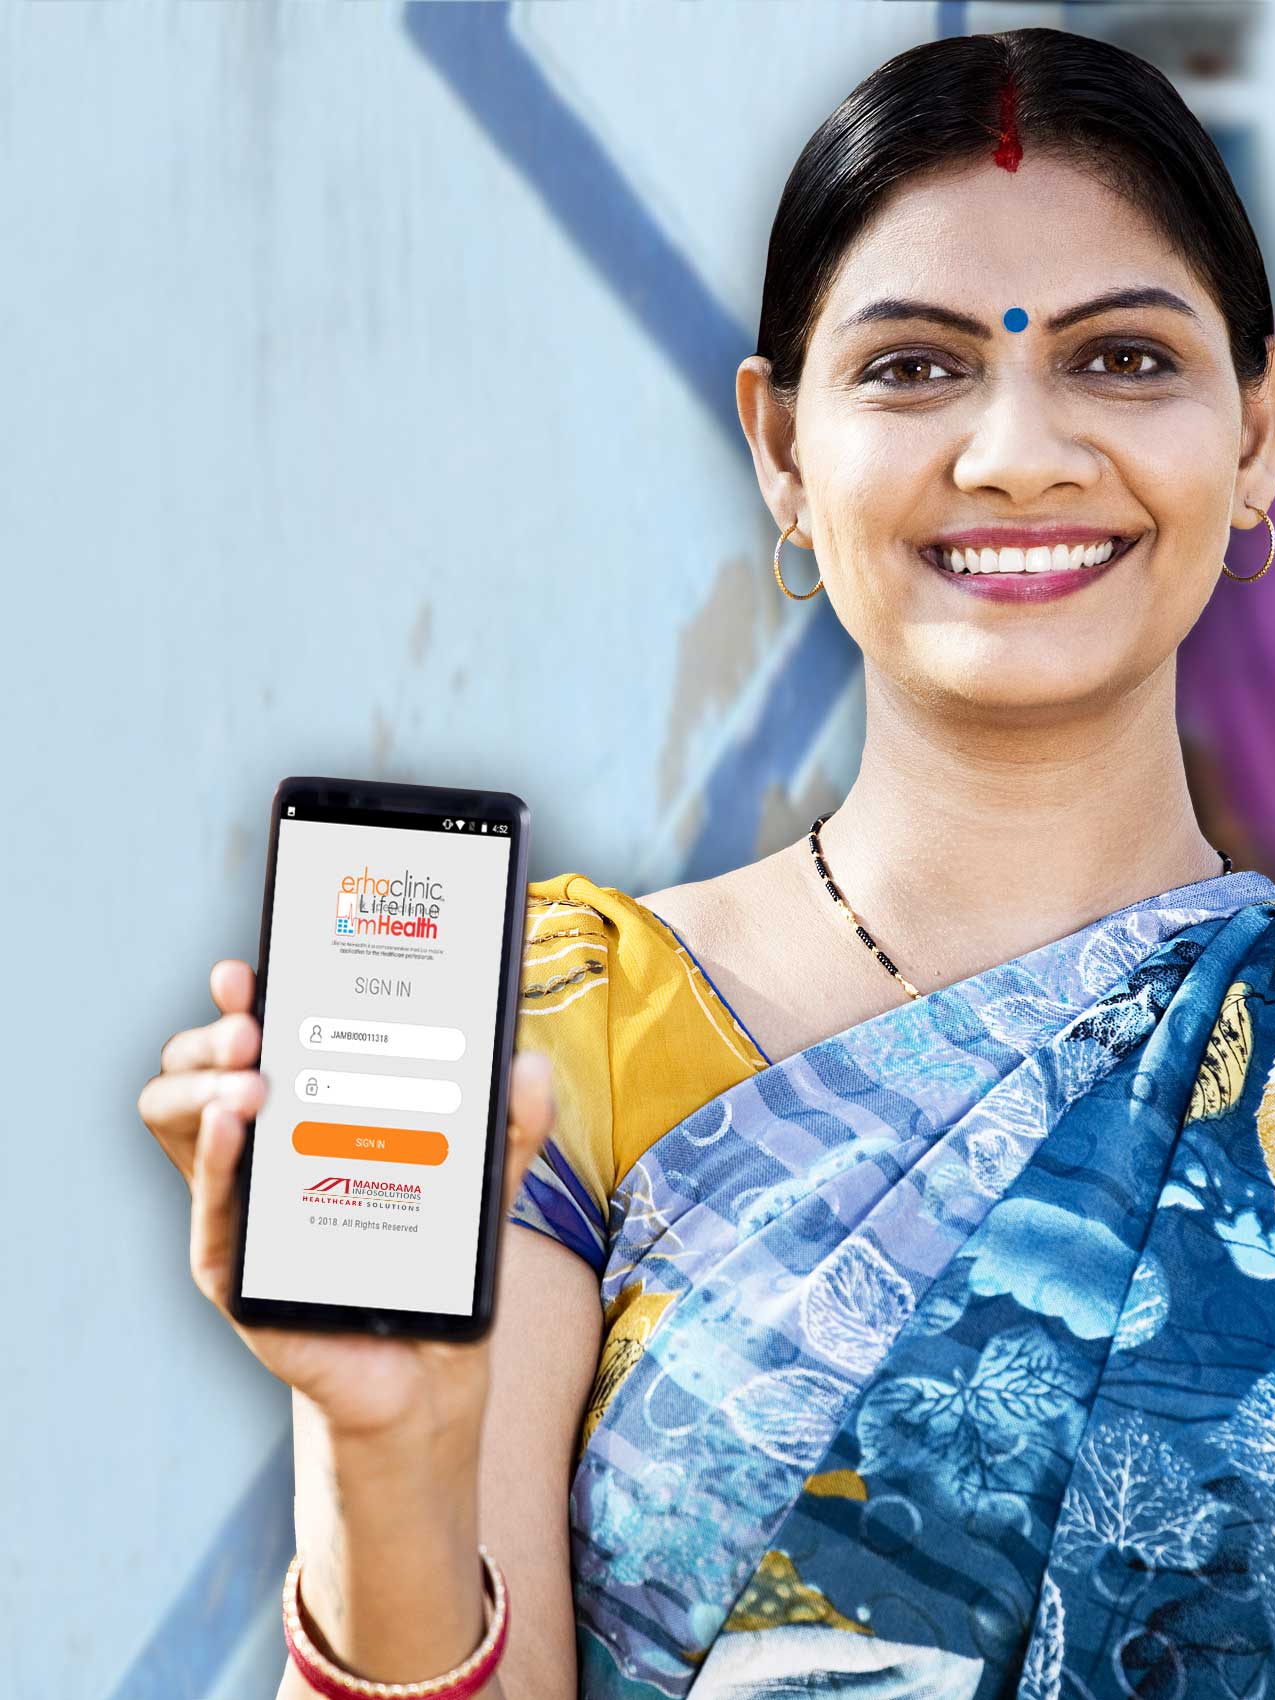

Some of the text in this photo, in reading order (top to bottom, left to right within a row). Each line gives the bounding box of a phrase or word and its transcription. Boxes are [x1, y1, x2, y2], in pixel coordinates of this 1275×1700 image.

[492, 824, 508, 834] 4:52
[359, 894, 440, 919] Lifeline
[357, 915, 438, 939] mHealth
[354, 976, 411, 998] SIGN IN
[355, 1138, 385, 1149] SIGN IN
[353, 1179, 421, 1193] MANORAMA
[352, 1188, 421, 1200] INFOSOLUTIONS
[302, 1196, 420, 1212] HEALTHCARE SOLUTIONS
[342, 1219, 353, 1228] All
[354, 1219, 380, 1231] Rights
[382, 1221, 418, 1233] Reserved
